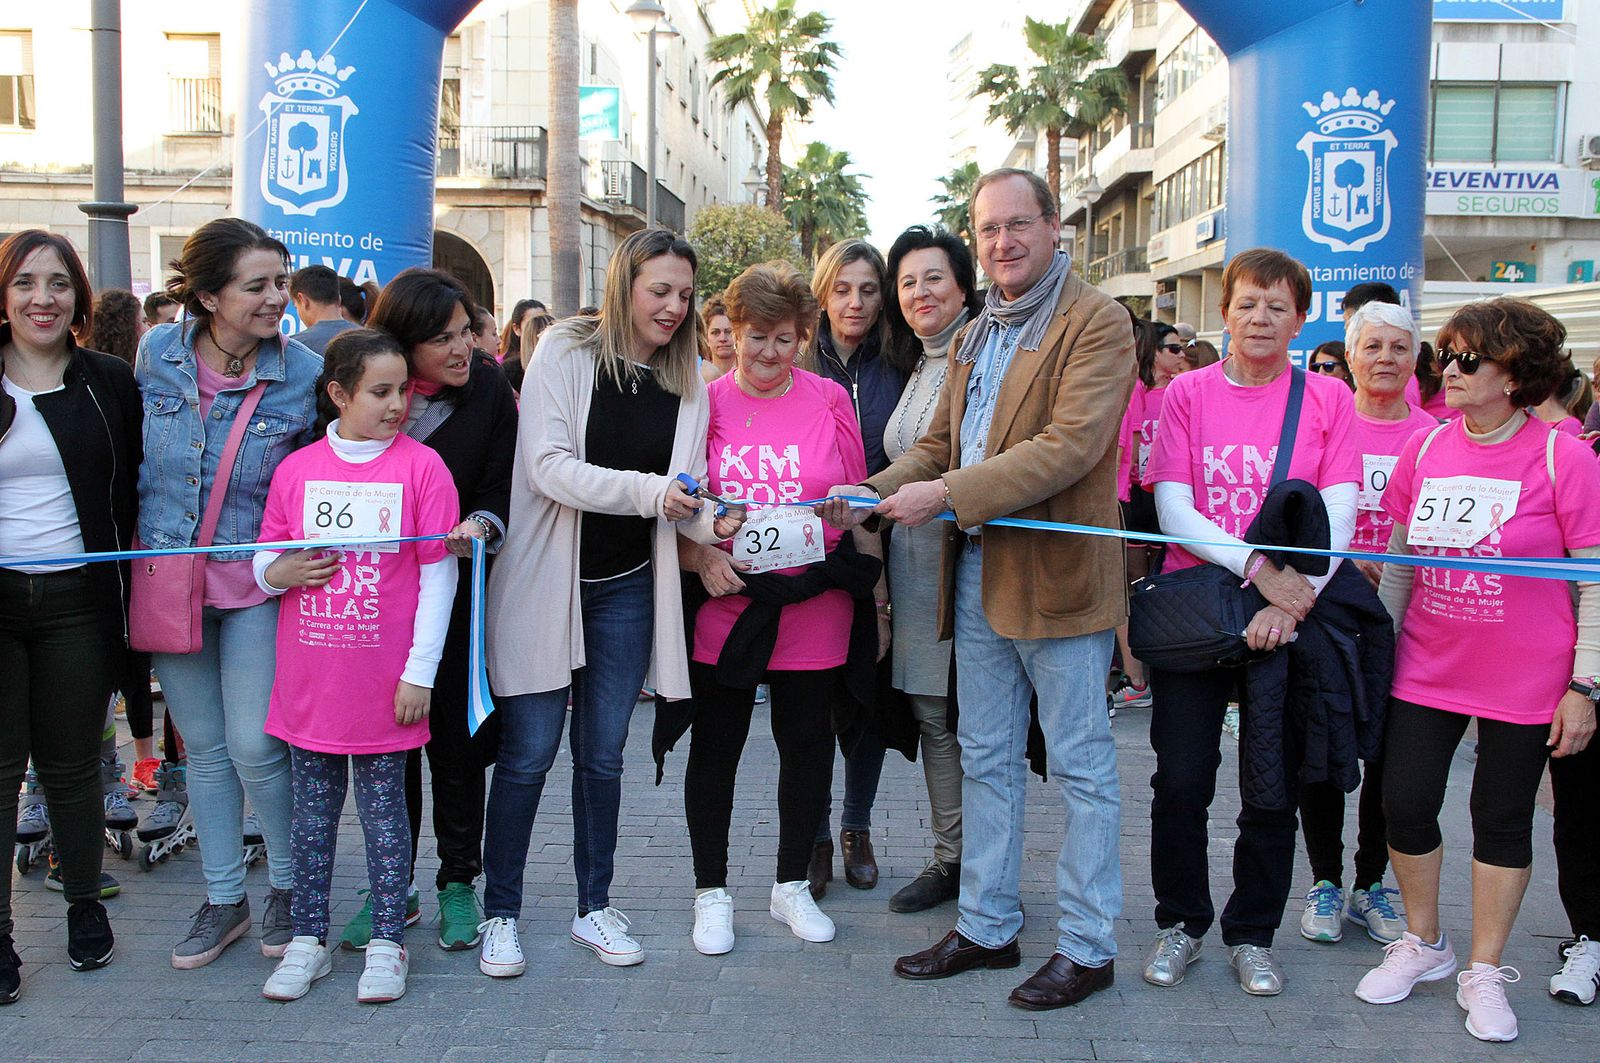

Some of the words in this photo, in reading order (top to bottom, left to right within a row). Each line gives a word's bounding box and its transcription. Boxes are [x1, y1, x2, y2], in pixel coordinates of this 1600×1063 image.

[285, 104, 294, 112] ET
[329, 131, 338, 172] CUSTODIA
[1329, 142, 1341, 151] ET
[269, 147, 277, 180] PORTUS
[1314, 157, 1322, 184] MARIS
[1374, 165, 1383, 207] CUSTODIA
[1313, 186, 1321, 219] PORTUS
[1456, 195, 1560, 214] SEGUROS
[360, 233, 384, 251] de
[1399, 262, 1414, 279] de
[719, 444, 801, 481] KM
[1203, 444, 1279, 485] KM
[319, 487, 351, 497] Carrera
[352, 489, 363, 497] de
[373, 490, 398, 499] Mujer
[1206, 486, 1269, 515] PO
[1436, 484, 1463, 492] Carrera
[1465, 483, 1476, 492] de
[1478, 484, 1487, 493] la
[1488, 486, 1516, 496] Mujer
[315, 501, 354, 529] 86
[1416, 497, 1476, 523] 512
[745, 526, 781, 555] 32
[1421, 566, 1503, 596] ELLAS
[299, 593, 381, 621] ELLAS
[1429, 589, 1452, 602] Carrera
[1453, 596, 1465, 604] de
[1467, 597, 1475, 605] la
[1478, 598, 1505, 608] Mujer
[306, 619, 332, 631] Carrera
[333, 623, 344, 631] de
[347, 623, 355, 631] la
[357, 623, 380, 632] Mujer
